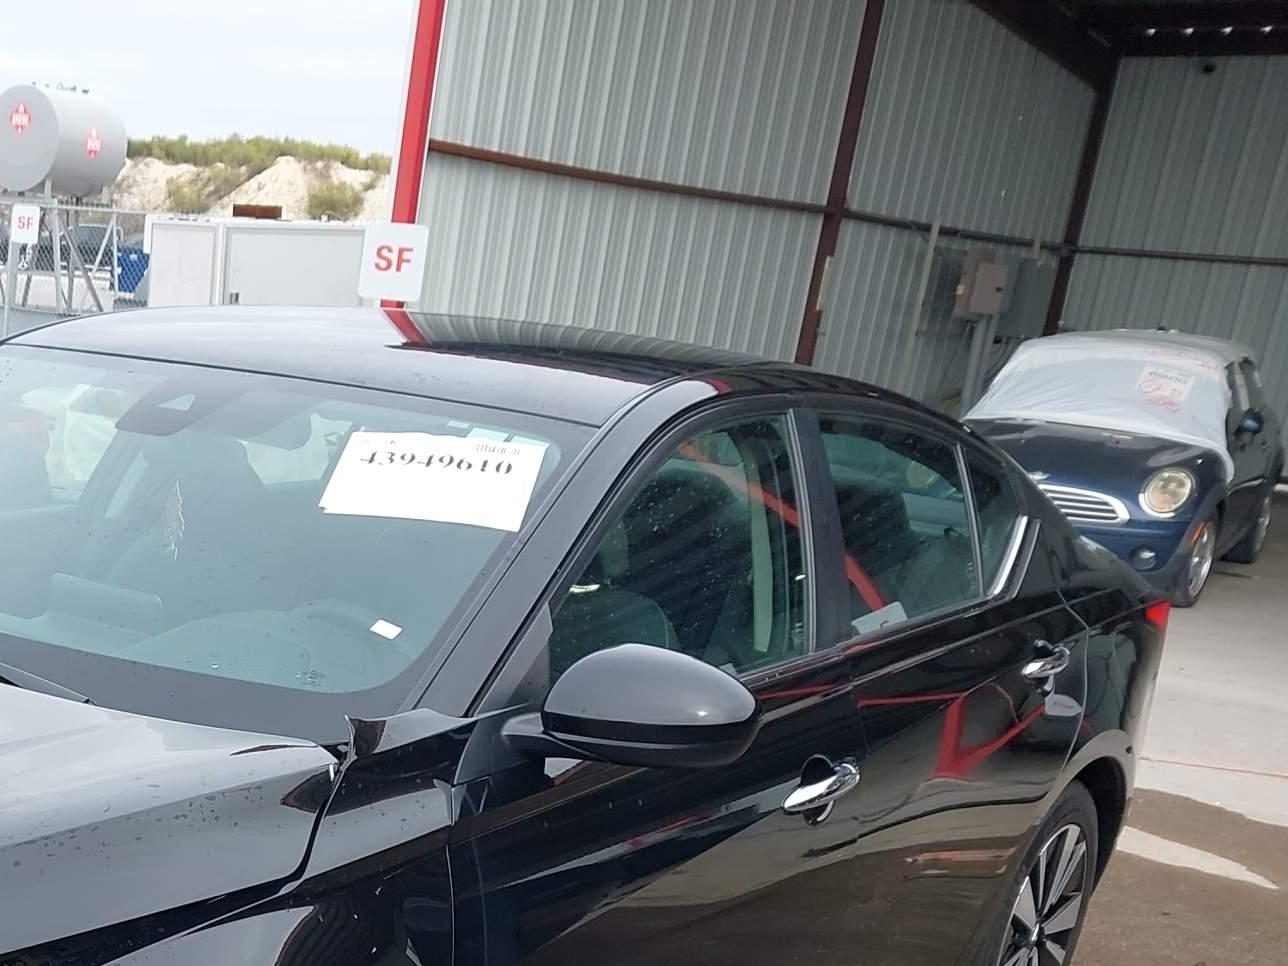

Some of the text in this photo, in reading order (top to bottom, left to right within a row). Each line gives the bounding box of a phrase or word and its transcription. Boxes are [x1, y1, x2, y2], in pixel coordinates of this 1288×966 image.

[17, 215, 33, 230] SF
[374, 244, 414, 272] SF
[360, 451, 513, 475] 43949610
